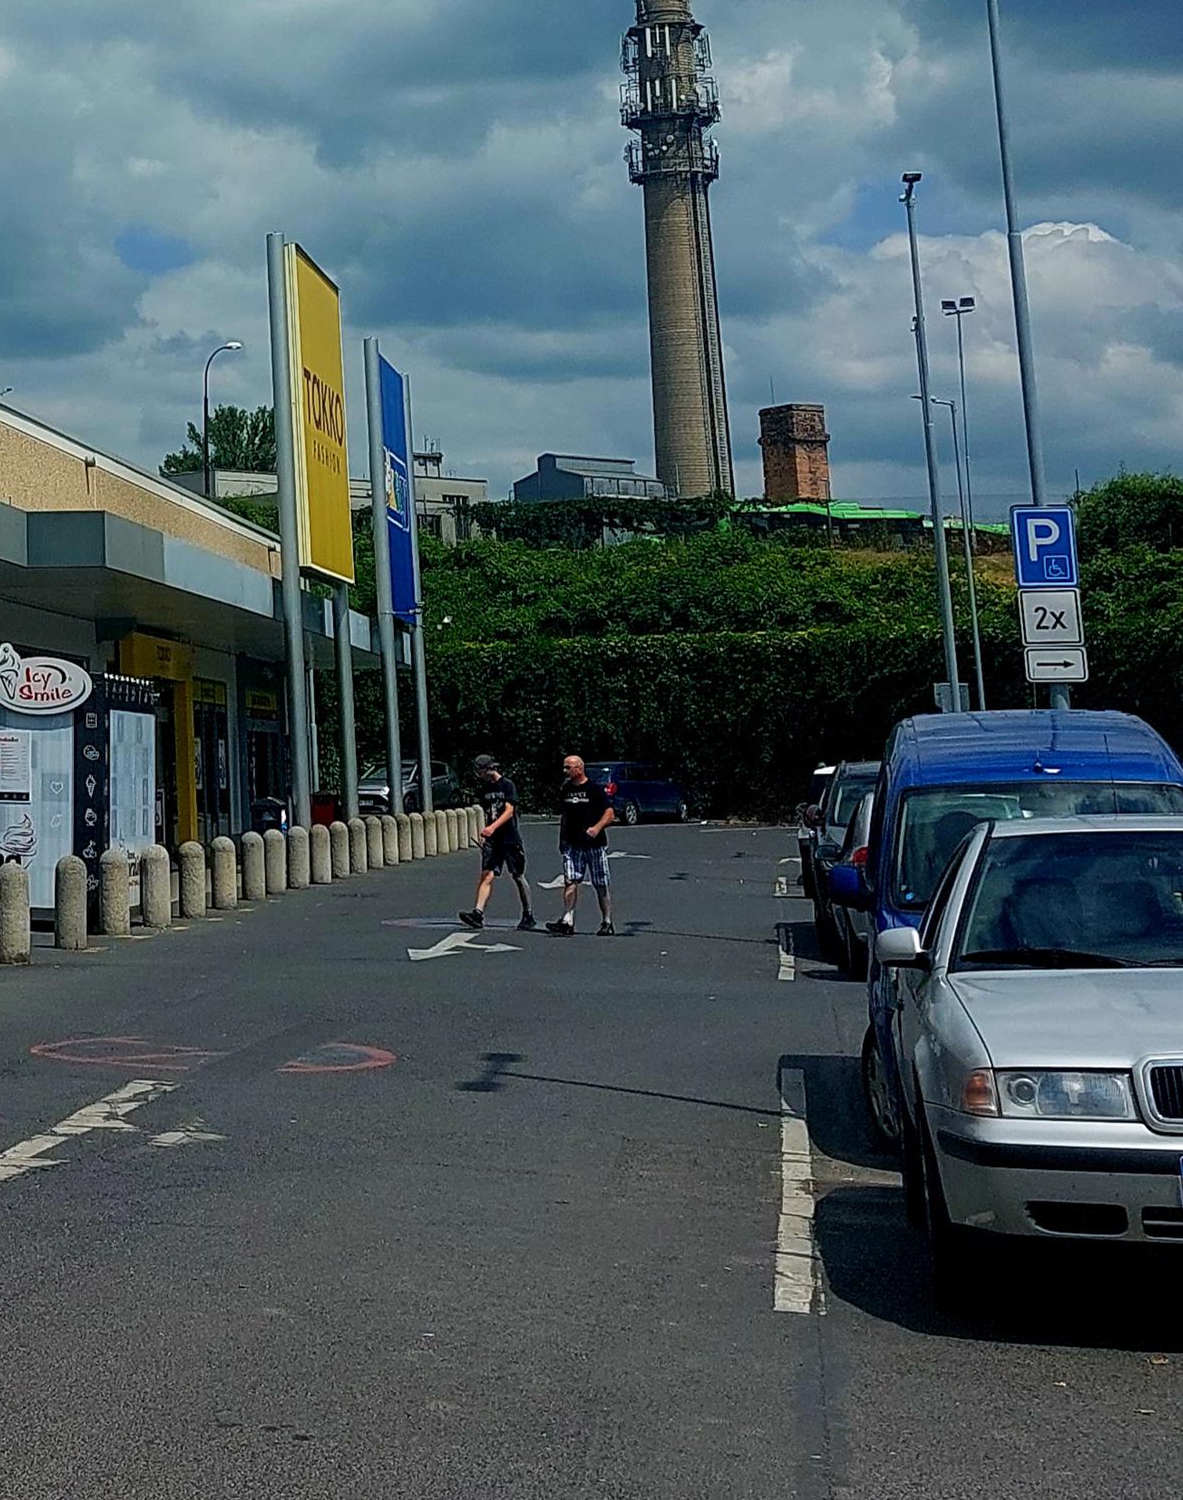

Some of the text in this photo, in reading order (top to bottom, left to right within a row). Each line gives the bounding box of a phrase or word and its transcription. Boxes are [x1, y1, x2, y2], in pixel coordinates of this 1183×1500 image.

[313, 439, 341, 474] FASHION
[1026, 518, 1060, 561] P
[1034, 606, 1067, 630] 2x
[25, 667, 52, 690] Icy
[19, 684, 73, 701] Smile
